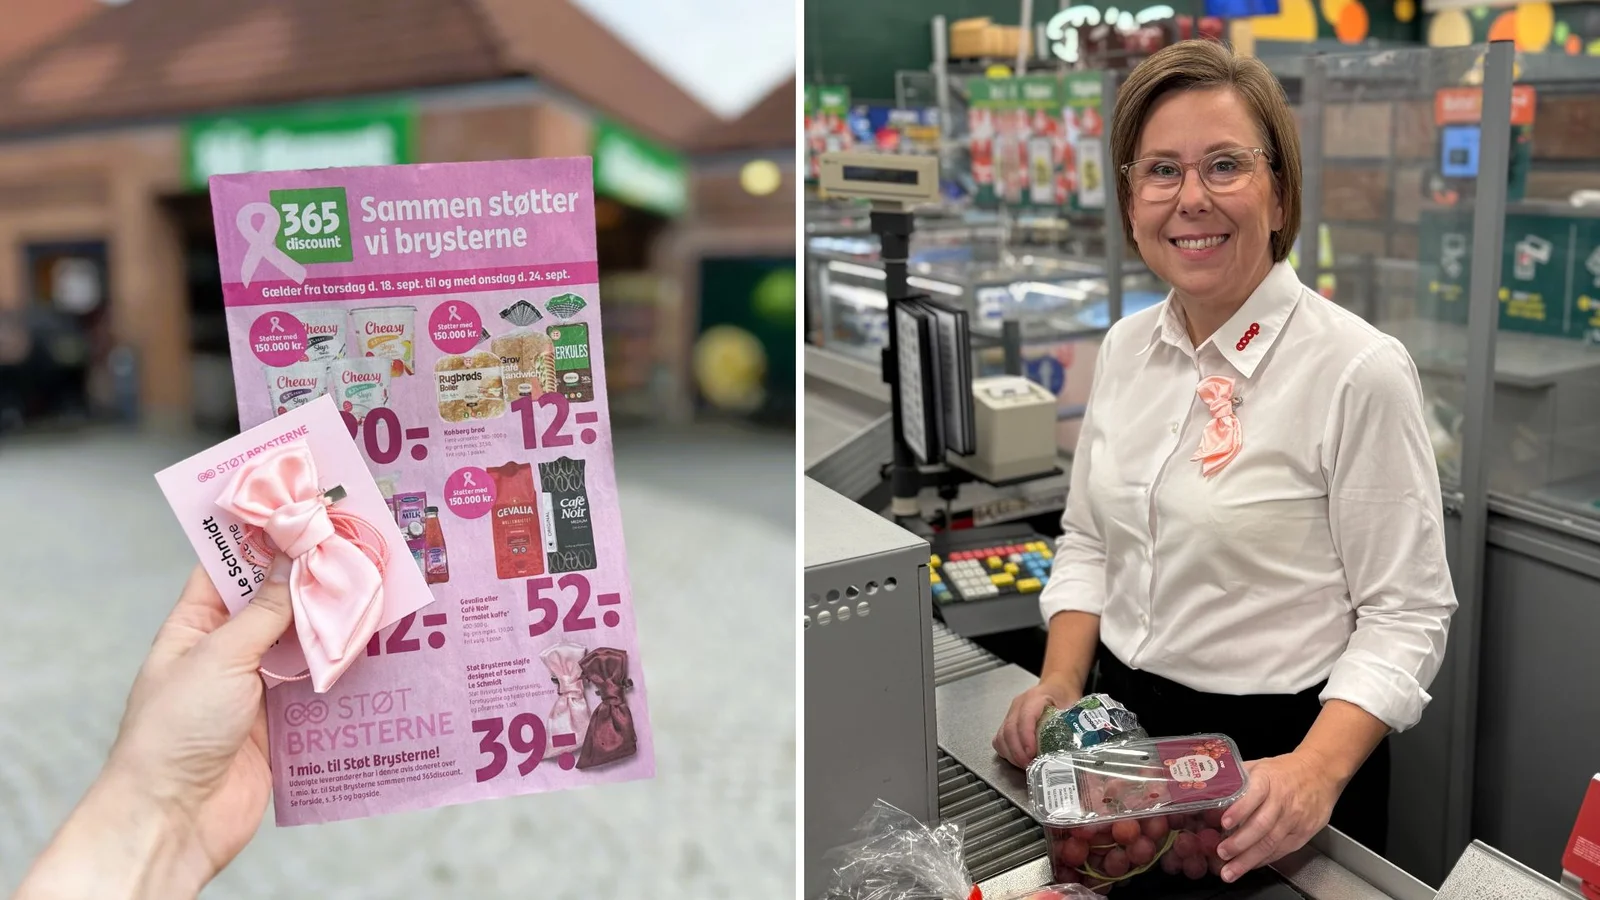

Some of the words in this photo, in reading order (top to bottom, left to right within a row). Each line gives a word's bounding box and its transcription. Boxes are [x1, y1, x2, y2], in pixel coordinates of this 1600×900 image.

[360, 195, 482, 222] Sammen
[489, 188, 579, 218] støtter
[281, 201, 340, 236] 365
[286, 235, 341, 250] discount
[364, 227, 389, 256] vi
[395, 225, 527, 259] brysterne
[262, 286, 301, 298] Gælder
[304, 284, 321, 295] fra
[323, 282, 366, 295] torsdag
[368, 281, 378, 291] d.
[380, 280, 395, 291] 18.
[397, 279, 423, 293] sept.
[425, 277, 436, 288] til
[438, 279, 452, 290] og
[453, 275, 476, 286] med
[479, 272, 516, 285] onsdag
[517, 271, 527, 282] d.
[529, 270, 543, 281] 24.
[546, 269, 571, 283] sept.
[365, 321, 404, 335] Cheasy
[437, 323, 459, 331] Støtter
[259, 334, 282, 342] Støtter
[433, 331, 466, 340] 150.000
[467, 329, 479, 338] kr.
[255, 342, 290, 353] 150.000
[292, 341, 304, 350] kr.
[555, 344, 588, 359] ERKULES
[277, 375, 317, 389] Cheasy
[342, 370, 381, 384] Cheasy
[439, 371, 482, 385] Rugbrøds
[246, 425, 309, 459] BRYSTERNE
[216, 453, 245, 474] STØT
[453, 488, 473, 496] Støtter
[449, 496, 480, 506] 150.000
[560, 495, 585, 509] Café
[402, 511, 421, 519] MILK
[497, 506, 533, 518] GEVALIA
[561, 506, 586, 519] Noir
[202, 516, 242, 577] Schmidt
[238, 577, 253, 597] Le
[460, 597, 483, 605] Gevalia
[462, 613, 490, 622] formalet
[467, 664, 480, 672] Støt
[481, 660, 512, 670] Brysterne
[467, 670, 495, 680] designet
[504, 667, 526, 675] Soeren
[476, 679, 502, 688] Schmidt
[338, 688, 412, 720] STØT
[287, 711, 454, 756] BRYSTERNE
[289, 765, 294, 777] 1
[297, 762, 325, 776] mio.
[327, 758, 341, 773] til
[344, 755, 370, 770] Støt
[373, 746, 440, 768] Brysterne!
[289, 778, 318, 787] Udvalgte
[319, 772, 361, 784] leverandører
[379, 767, 399, 776] denne
[400, 765, 414, 773] avis
[415, 762, 440, 771] doneret
[329, 785, 342, 793] Støt
[344, 781, 376, 792] Brysterne
[377, 777, 405, 786] sammen
[406, 774, 421, 782] med
[290, 799, 298, 807] Se
[354, 789, 381, 799] bagside.
